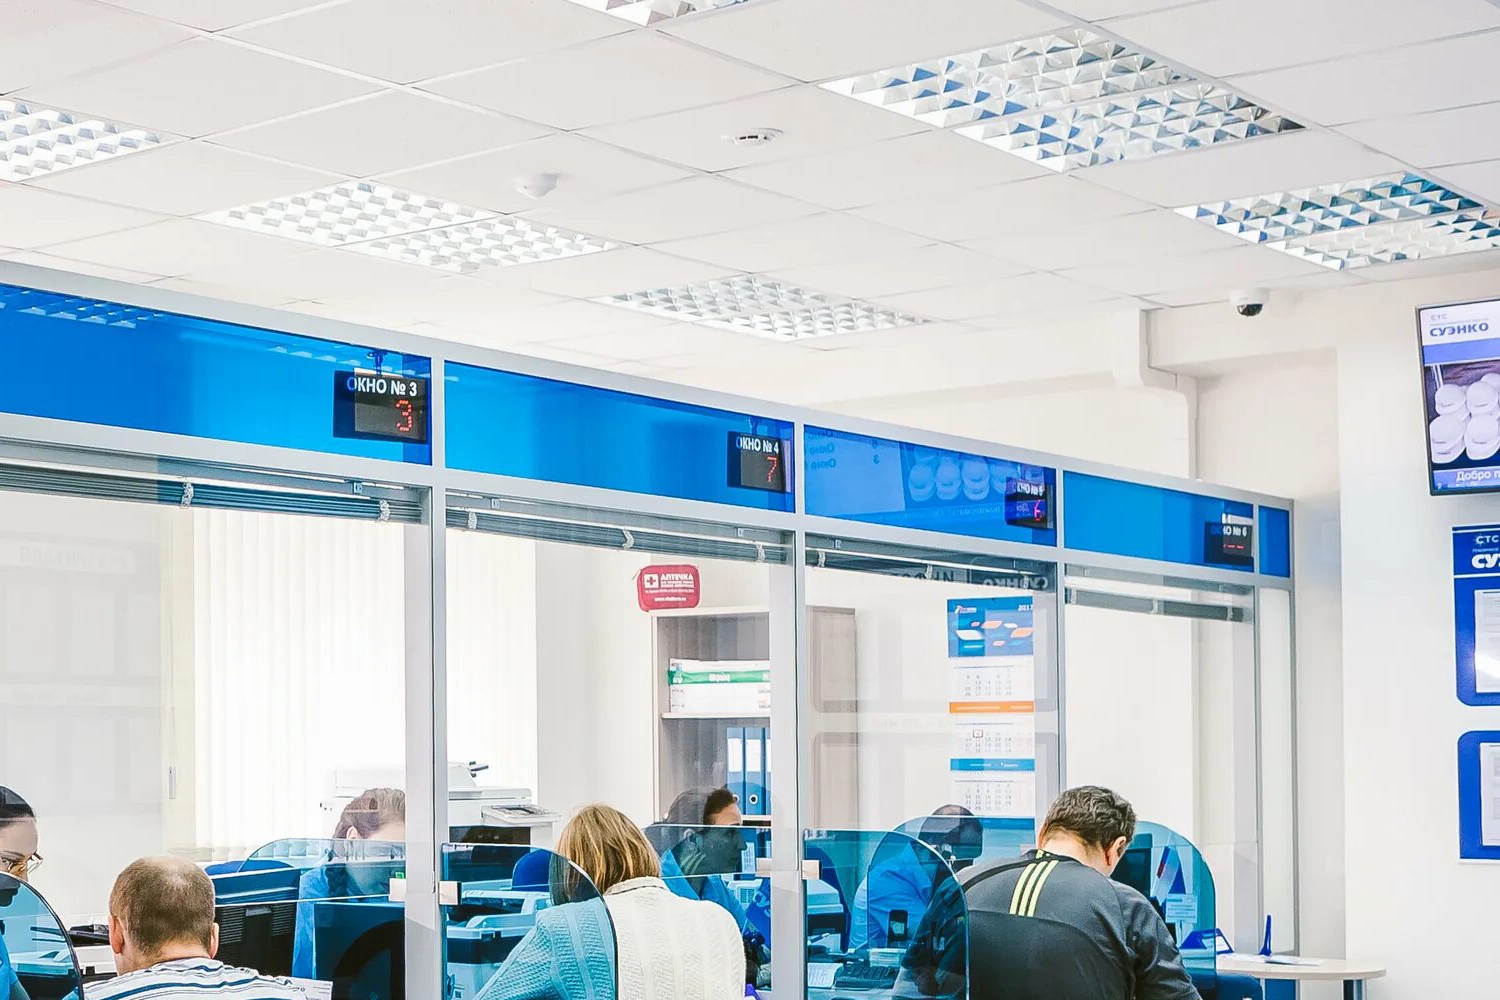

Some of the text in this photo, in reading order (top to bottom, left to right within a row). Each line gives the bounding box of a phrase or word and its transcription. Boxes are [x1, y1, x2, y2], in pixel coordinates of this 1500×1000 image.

[1429, 322, 1489, 337] СУЭНКО
[346, 377, 417, 397] ОКНО № 3
[396, 399, 413, 432] 3
[736, 436, 761, 451] ОКНО
[773, 442, 779, 454] 4
[766, 456, 778, 482] 7
[1456, 470, 1492, 481] Добро
[1475, 535, 1499, 544] СТС
